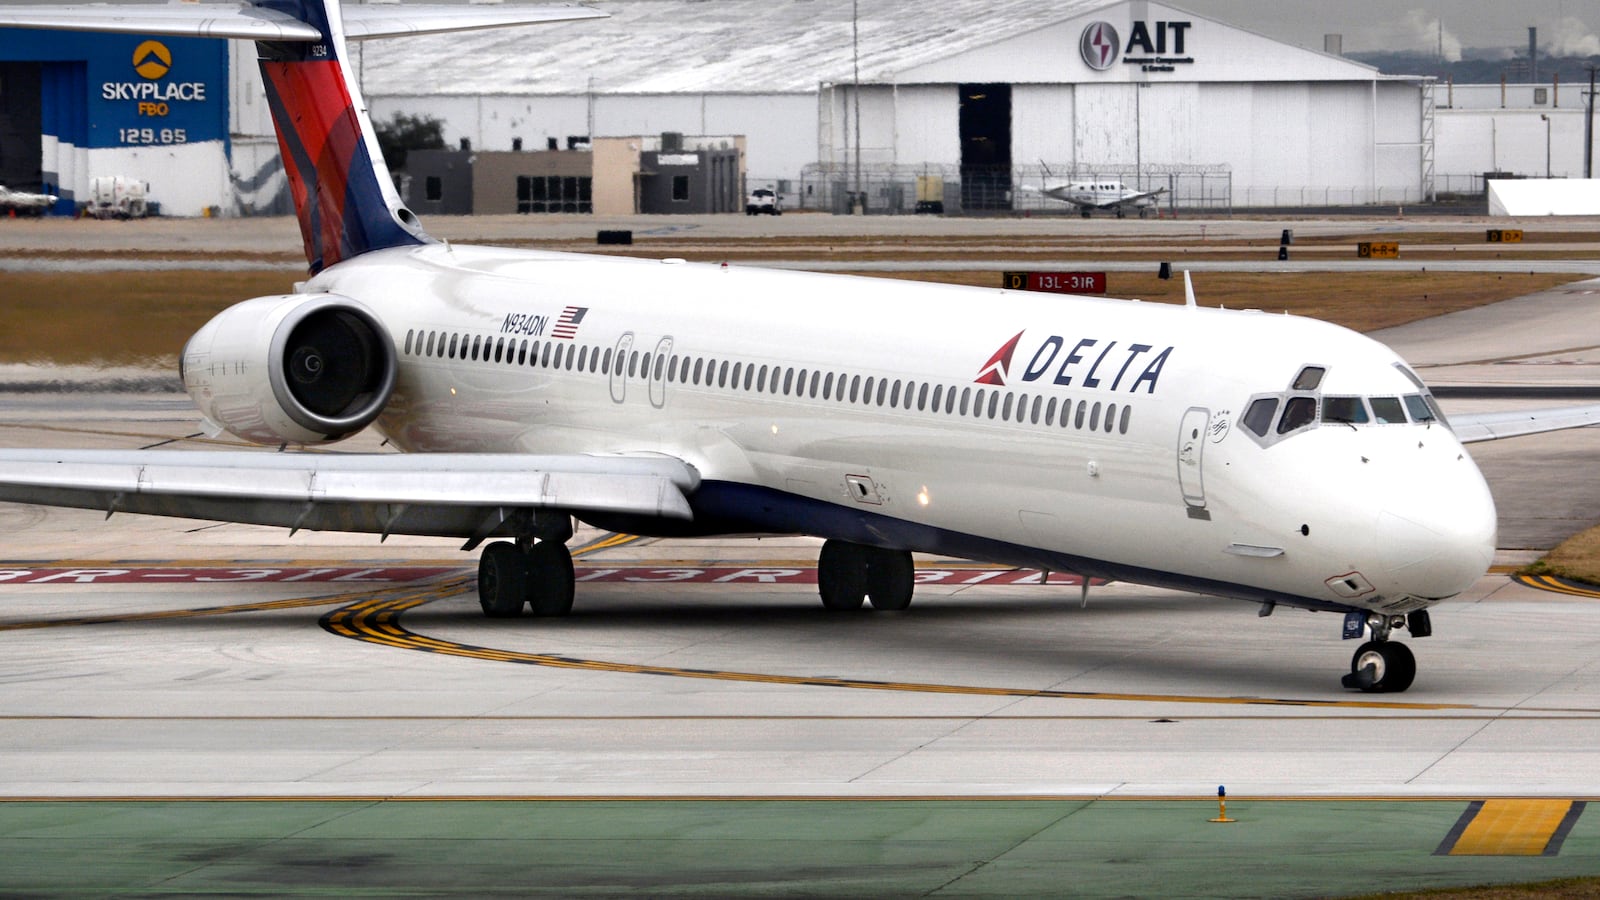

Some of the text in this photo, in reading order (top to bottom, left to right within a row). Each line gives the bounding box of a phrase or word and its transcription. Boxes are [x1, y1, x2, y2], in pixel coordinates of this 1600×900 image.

[1124, 21, 1192, 54] AIT
[312, 44, 327, 57] 9234
[102, 82, 206, 100] SKYPLACE
[138, 101, 169, 116] FBO
[119, 128, 187, 143] 129.85
[1011, 275, 1095, 289] D 13L-31R
[500, 312, 550, 337] N934DN
[1021, 335, 1175, 394] DELTA
